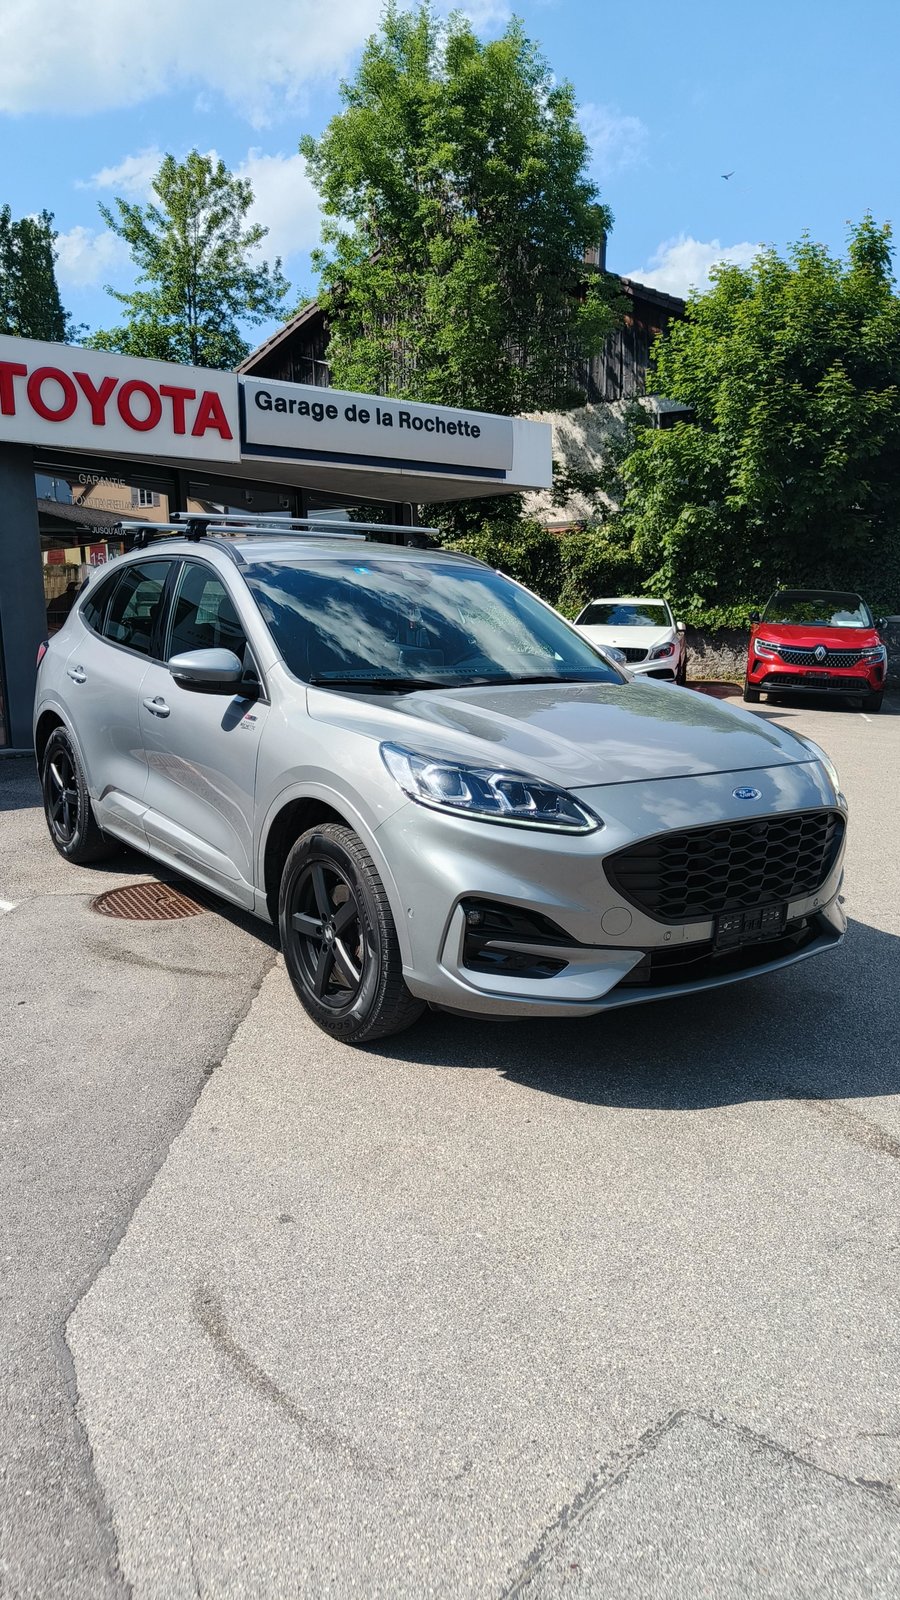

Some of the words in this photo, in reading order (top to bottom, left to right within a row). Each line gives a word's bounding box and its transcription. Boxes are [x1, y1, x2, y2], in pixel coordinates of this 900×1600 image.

[0, 361, 233, 440] TOYOTA
[254, 390, 338, 422] Garage
[344, 403, 371, 424] de
[376, 407, 393, 427] la
[399, 410, 481, 438] Rochette
[78, 473, 126, 489] GARANTIE
[90, 552, 105, 566] 15
